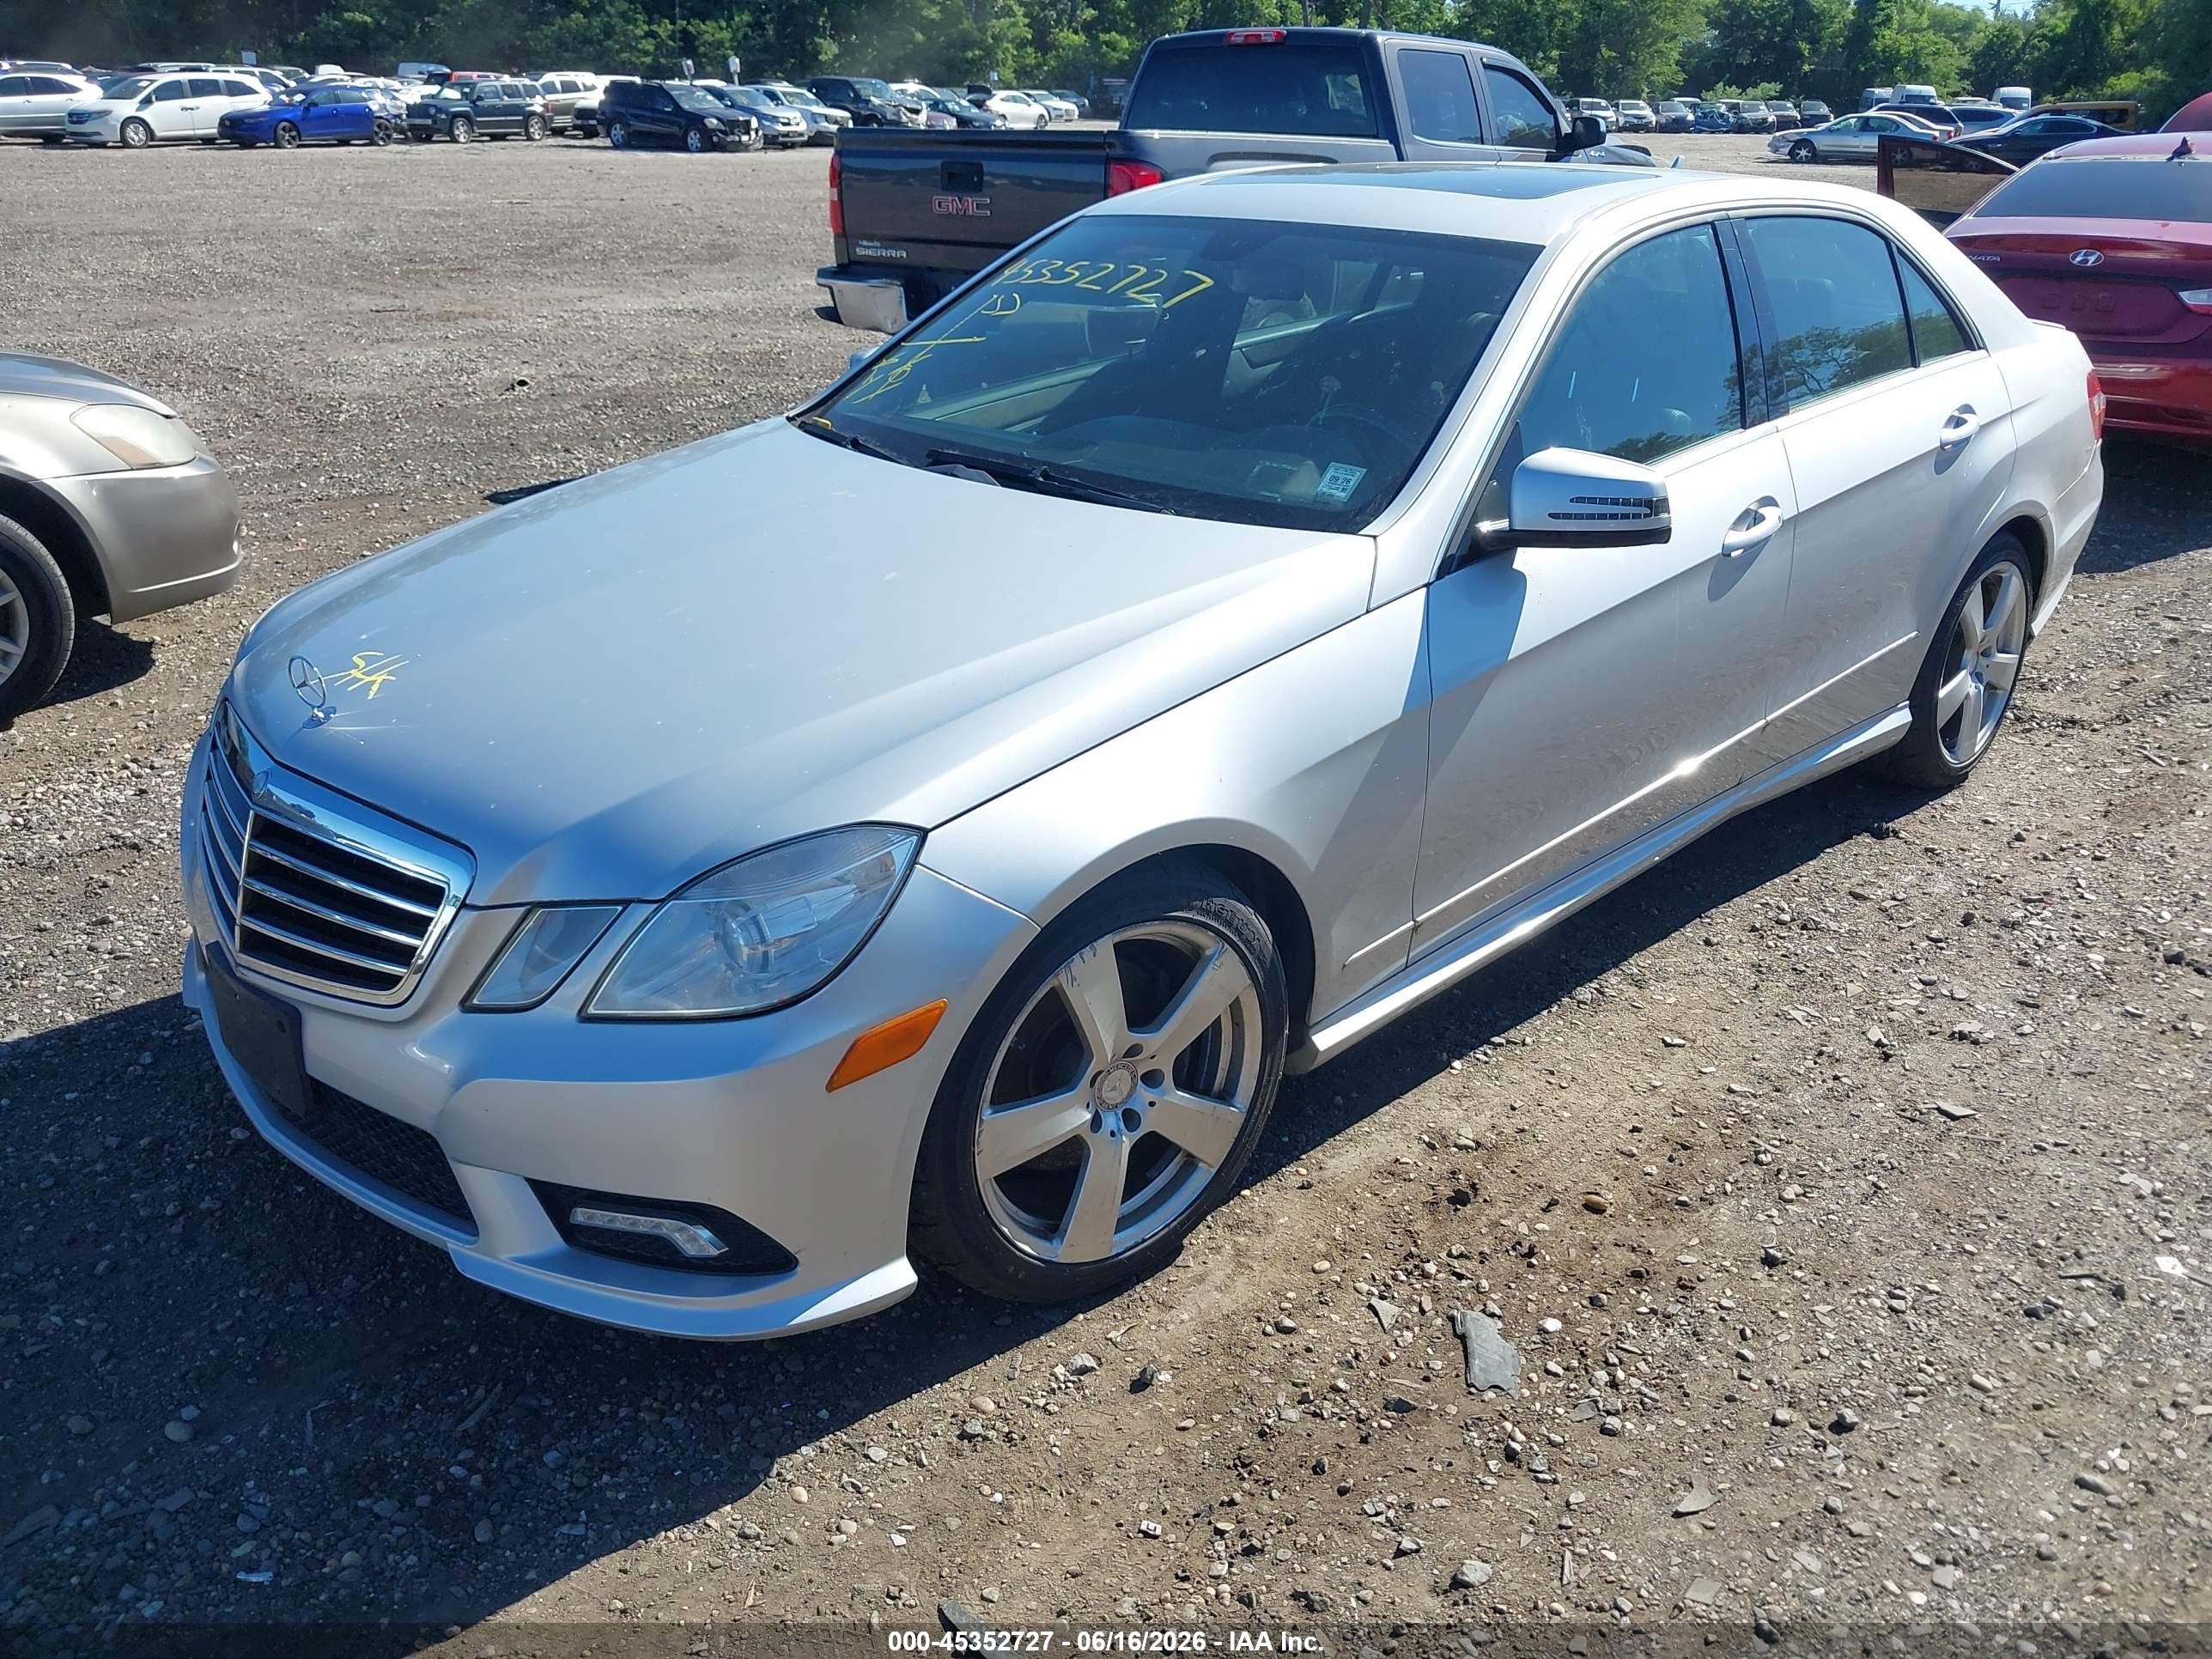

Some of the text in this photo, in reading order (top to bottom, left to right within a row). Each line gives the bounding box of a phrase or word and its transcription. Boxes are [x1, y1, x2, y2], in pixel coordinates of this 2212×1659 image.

[933, 196, 991, 216] GMC
[855, 246, 907, 259] SIERRA
[991, 258, 1215, 309] 45352727
